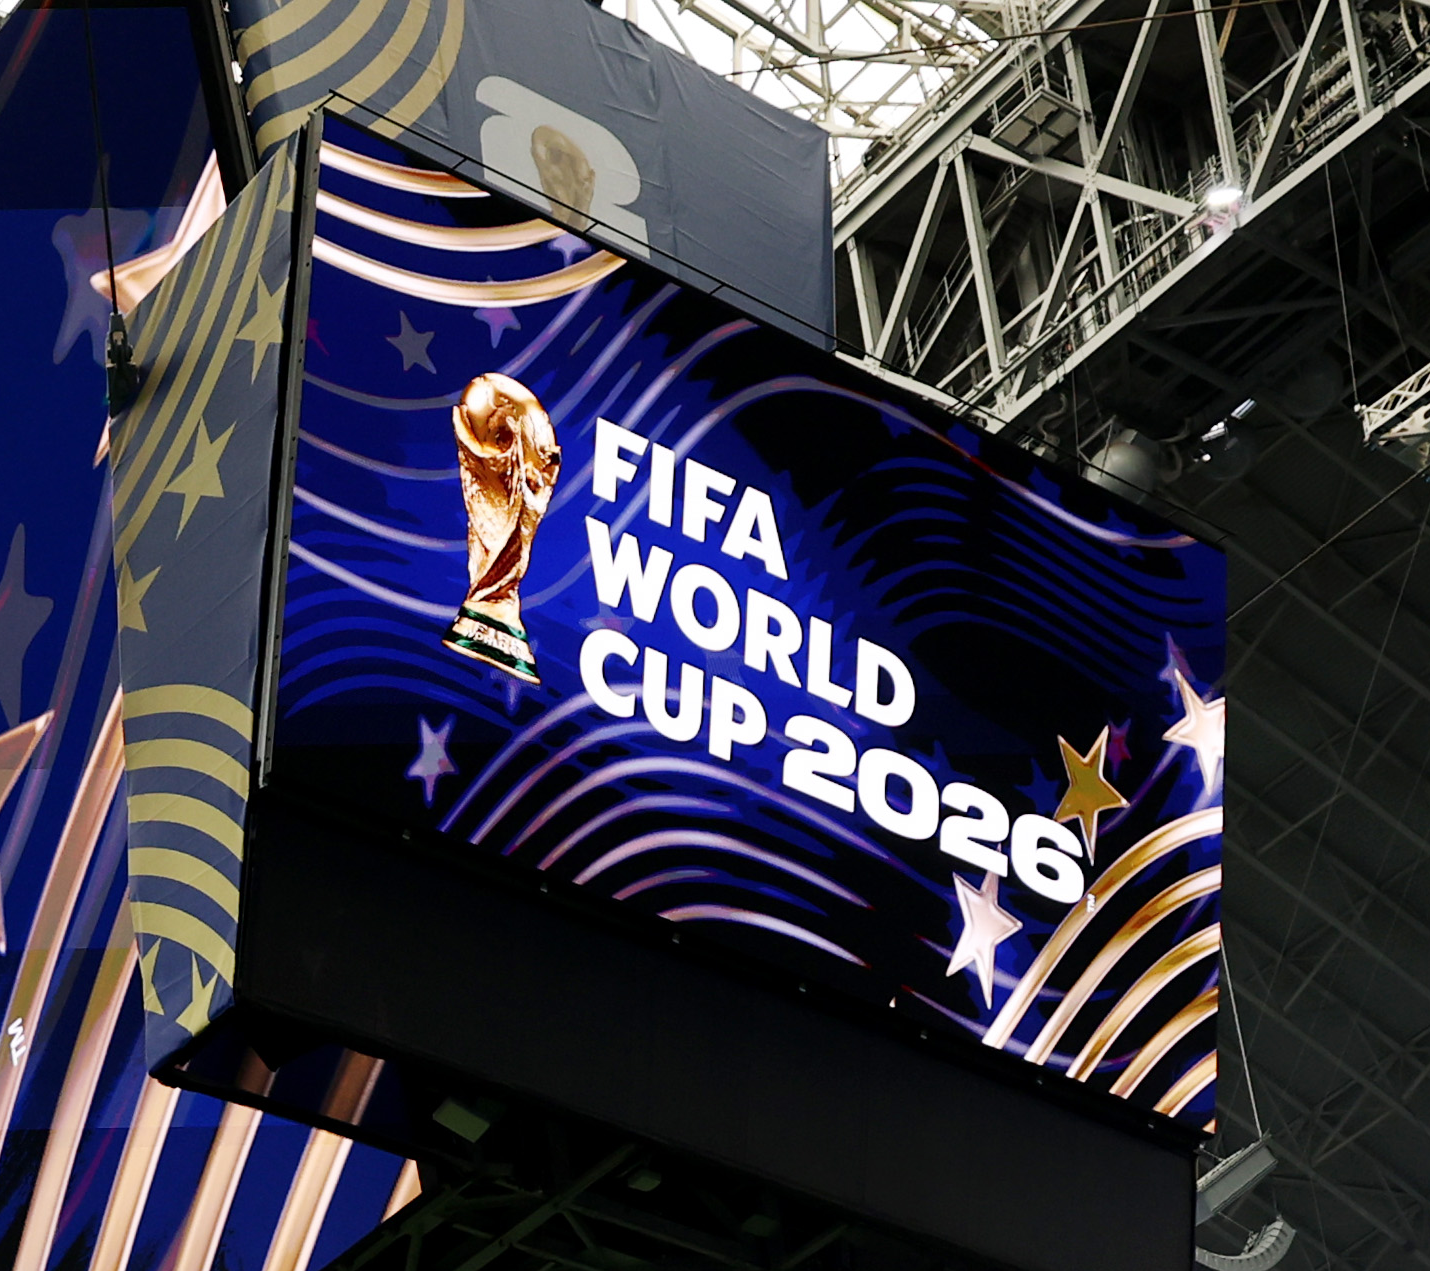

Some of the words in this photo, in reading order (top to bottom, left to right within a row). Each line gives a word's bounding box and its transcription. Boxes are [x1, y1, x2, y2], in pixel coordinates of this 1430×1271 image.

[593, 417, 788, 580] FIFA
[585, 516, 915, 726] WORLD
[580, 629, 767, 761] CUP
[783, 715, 1084, 903] 2026
